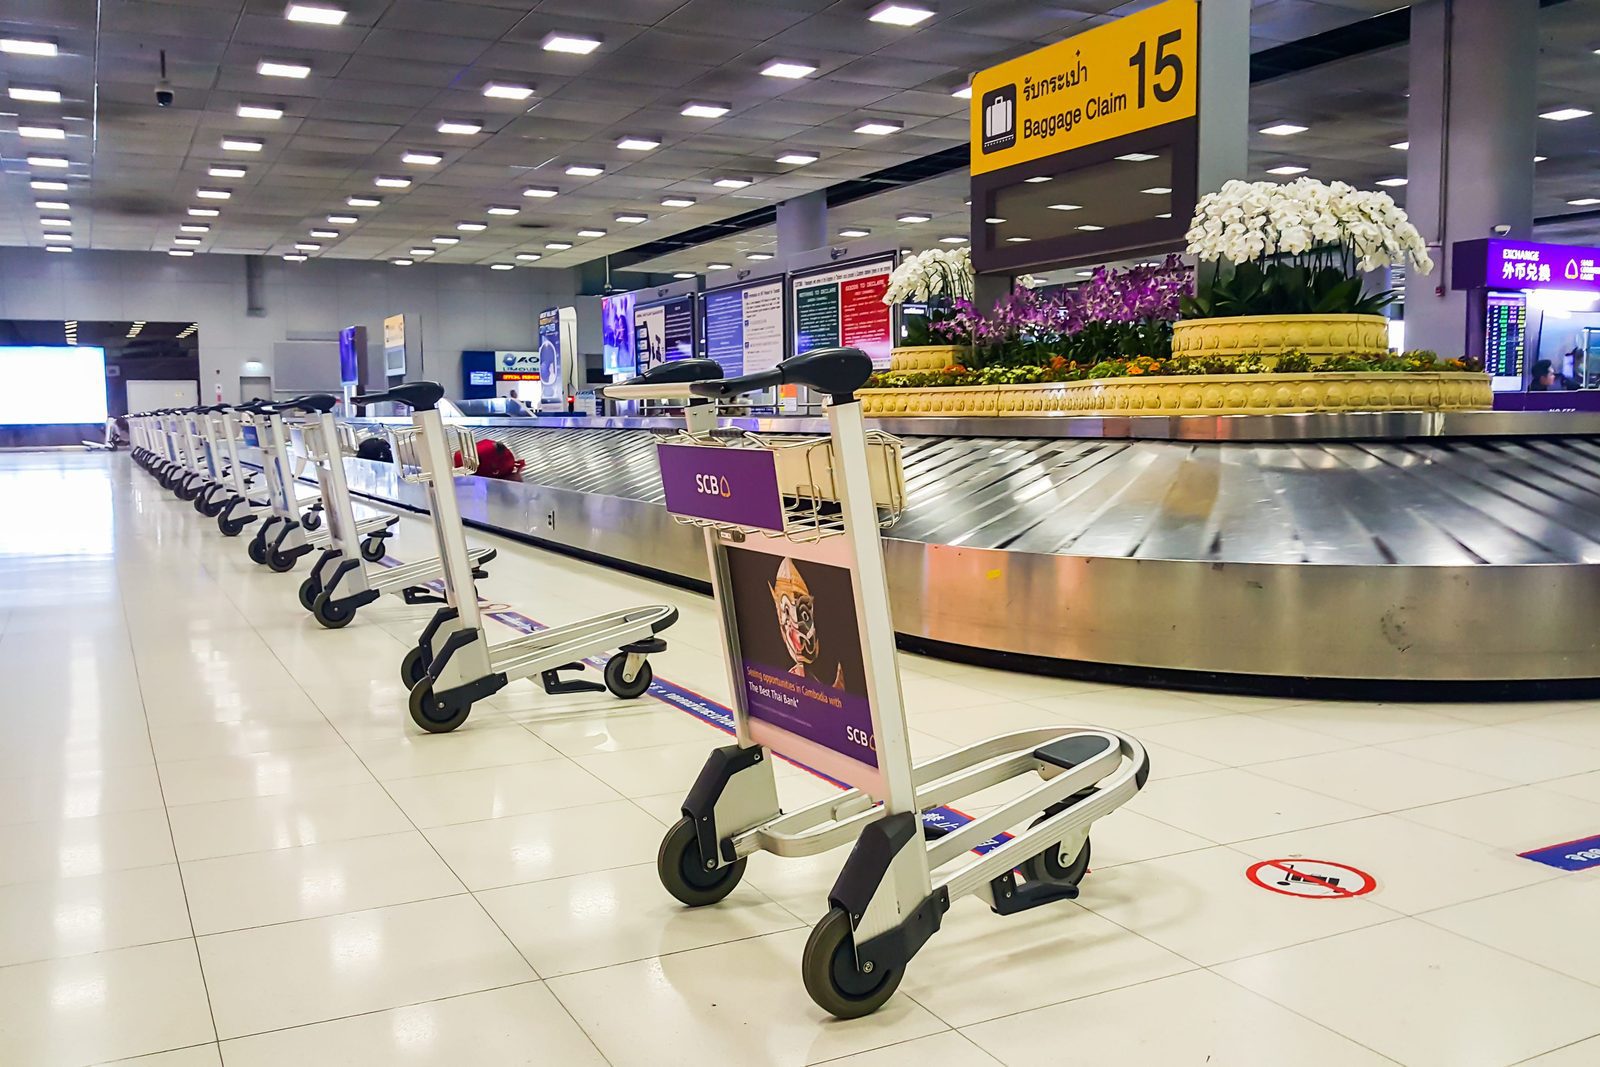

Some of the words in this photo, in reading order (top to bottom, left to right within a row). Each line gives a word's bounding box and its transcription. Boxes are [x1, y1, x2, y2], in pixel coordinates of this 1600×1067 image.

[1023, 49, 1088, 101] รับกระเป๋า
[1129, 28, 1183, 109] 15
[1024, 105, 1081, 139] Baggage
[1085, 93, 1127, 120] Claim
[1503, 249, 1540, 261] EXCHANGE
[1502, 263, 1551, 282] 外币兑换
[695, 474, 719, 496] SCB
[748, 681, 758, 693] The
[759, 685, 771, 698] Best
[770, 690, 783, 702] Thai
[762, 673, 796, 692] opportunities
[796, 682, 800, 693] in
[802, 685, 828, 704] Cambodia
[829, 696, 842, 708] with
[846, 725, 869, 747] SCB
